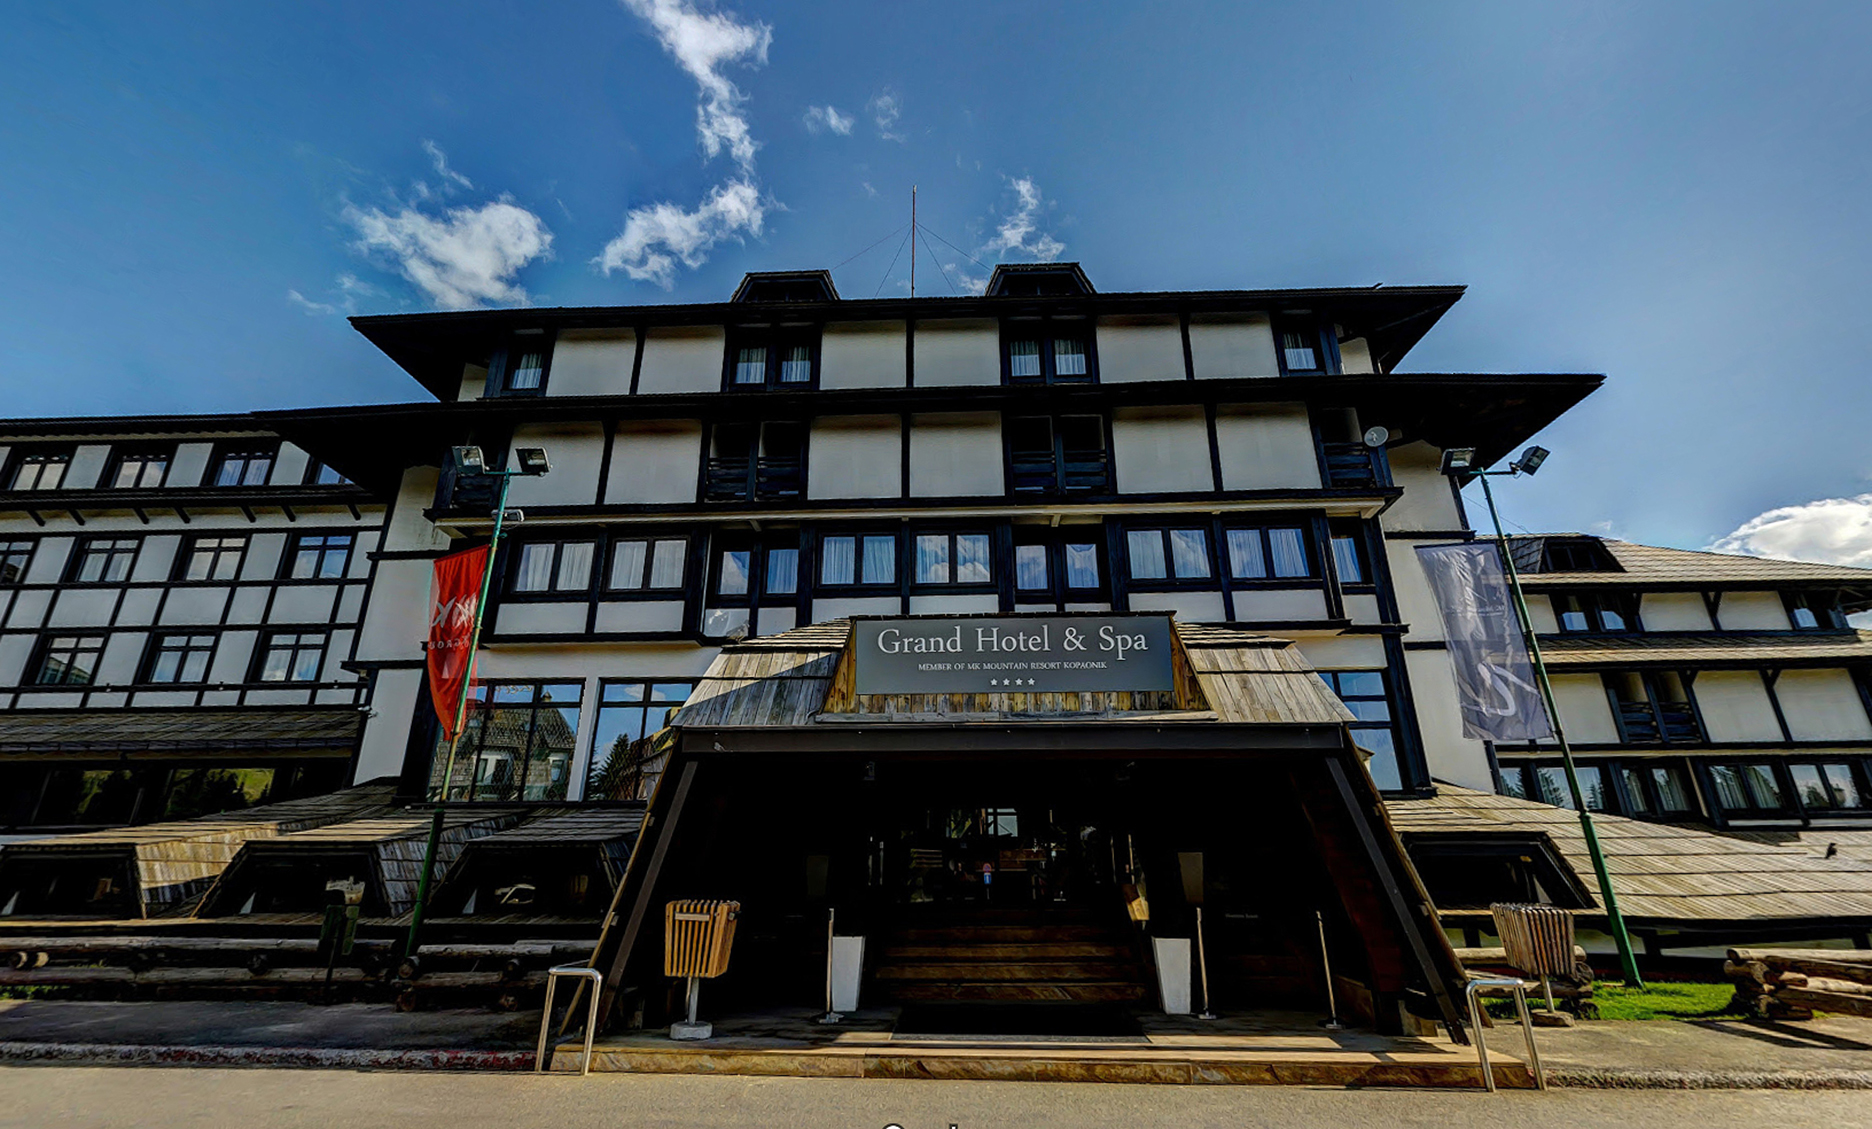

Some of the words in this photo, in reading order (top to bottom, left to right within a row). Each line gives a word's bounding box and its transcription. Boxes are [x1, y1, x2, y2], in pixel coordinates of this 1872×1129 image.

[878, 625, 963, 653] Grand
[975, 624, 1051, 651] Hotel
[1063, 627, 1087, 651] &
[1099, 625, 1148, 660] Spa
[918, 663, 952, 671] MEMBER
[954, 662, 965, 670] OF
[967, 662, 981, 670] MK
[982, 662, 1028, 670] MOUNTAIN
[1030, 662, 1061, 670] RESORT
[1063, 661, 1107, 670] KOPAONIK
